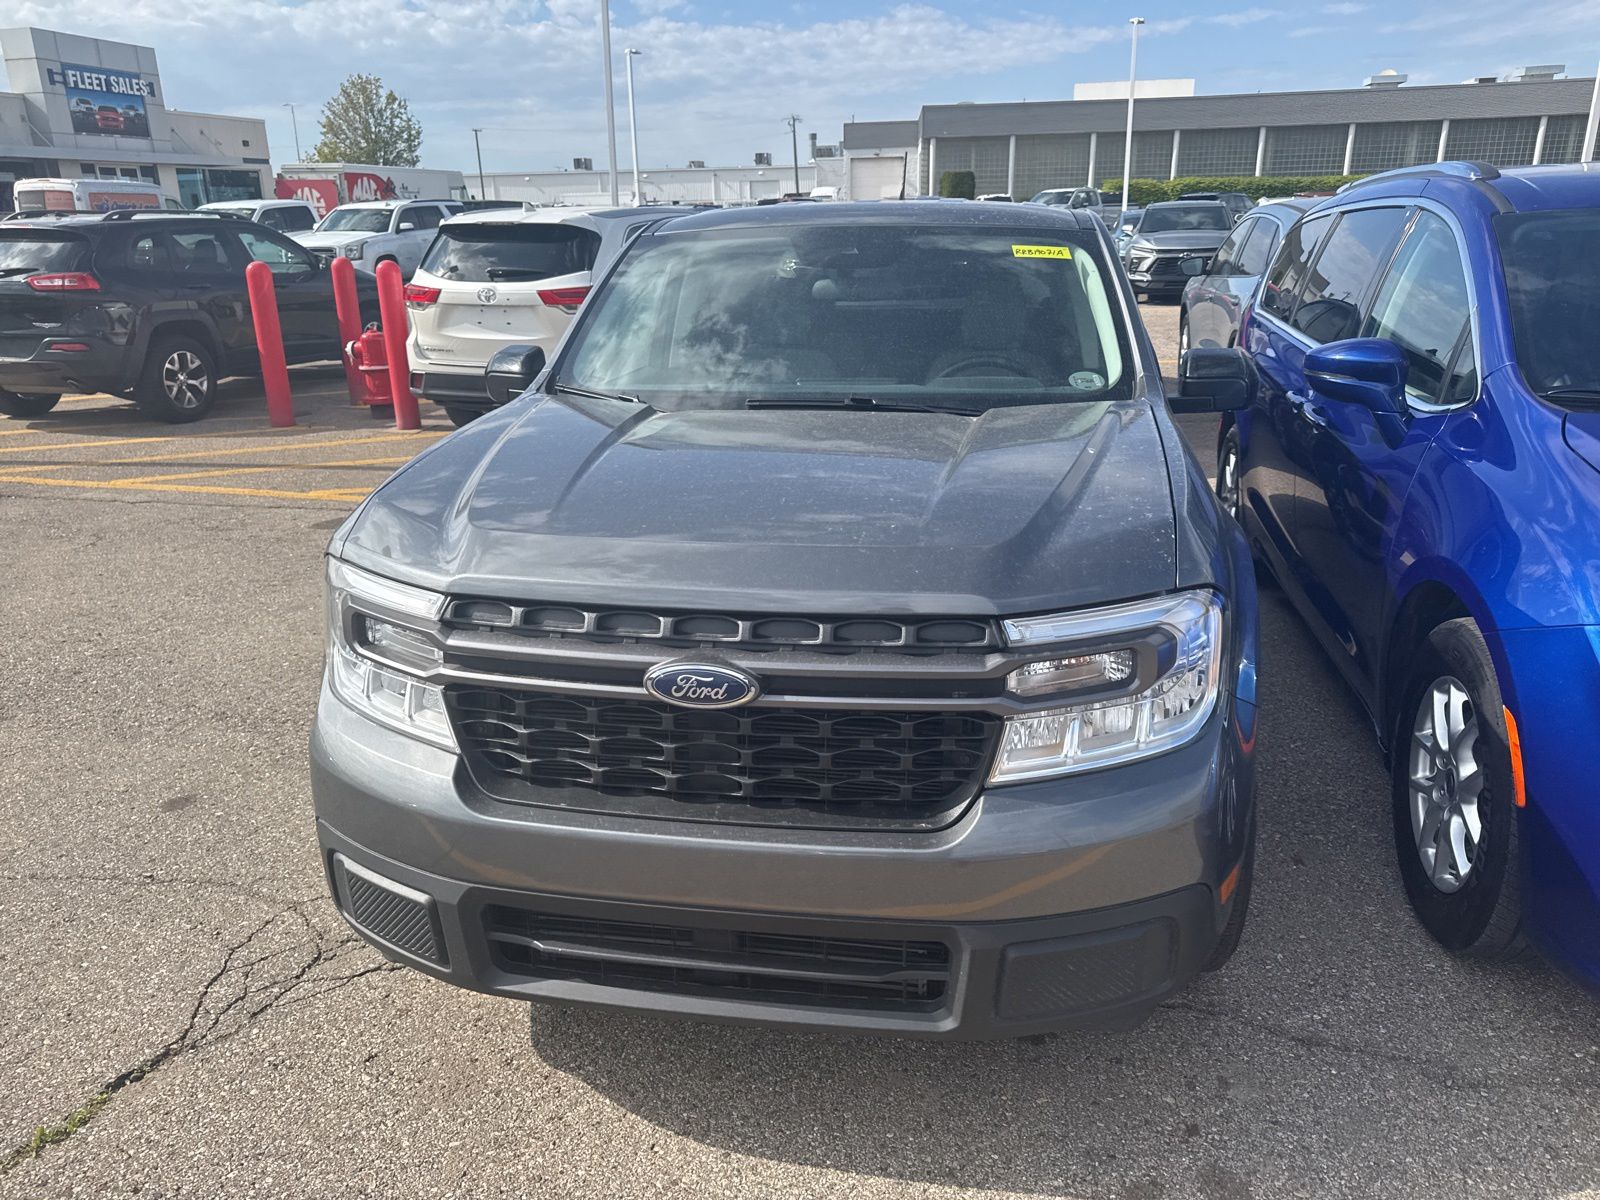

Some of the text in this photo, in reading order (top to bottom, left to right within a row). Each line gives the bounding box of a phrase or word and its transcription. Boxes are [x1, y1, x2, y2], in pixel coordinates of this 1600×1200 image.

[67, 69, 148, 97] FLEET SALES
[671, 674, 729, 700] Ford
